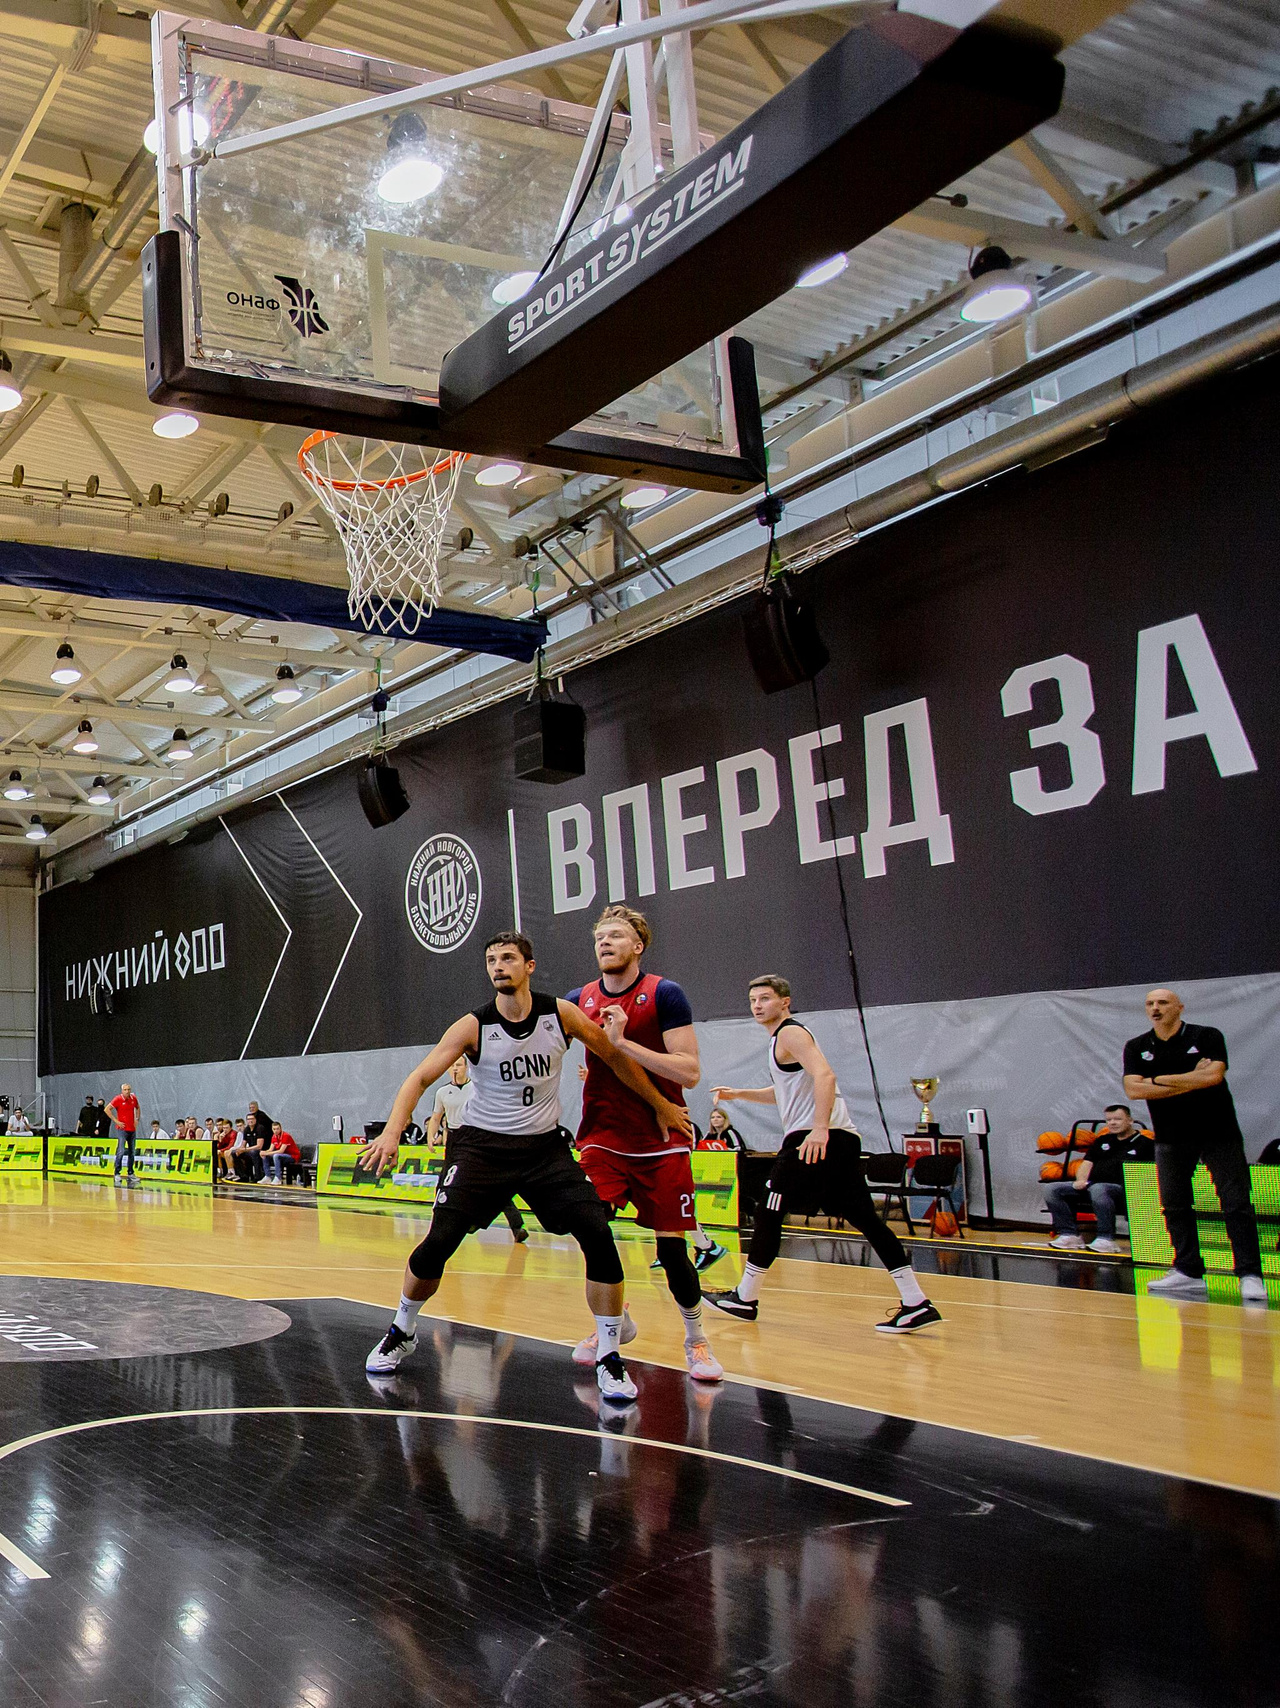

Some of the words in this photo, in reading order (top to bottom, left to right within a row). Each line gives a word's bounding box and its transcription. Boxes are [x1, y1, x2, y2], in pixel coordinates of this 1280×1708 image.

[547, 697, 955, 915] ВПЕРЕД
[1000, 613, 1258, 816] ЗА
[410, 843, 437, 887] НИЖНИЙ
[436, 841, 474, 875] НОВГОРОД
[410, 905, 467, 946] БАСКЕТБОЛЬНЫЙ
[462, 893, 477, 924] КЛУБ
[65, 930, 170, 1001] НИЖНИЙ
[174, 922, 226, 980] 800
[499, 1053, 551, 1082] BCNN
[522, 1085, 535, 1107] 8
[443, 1164, 458, 1187] 8
[680, 1193, 695, 1218] 2
[607, 1327, 617, 1337] 8
